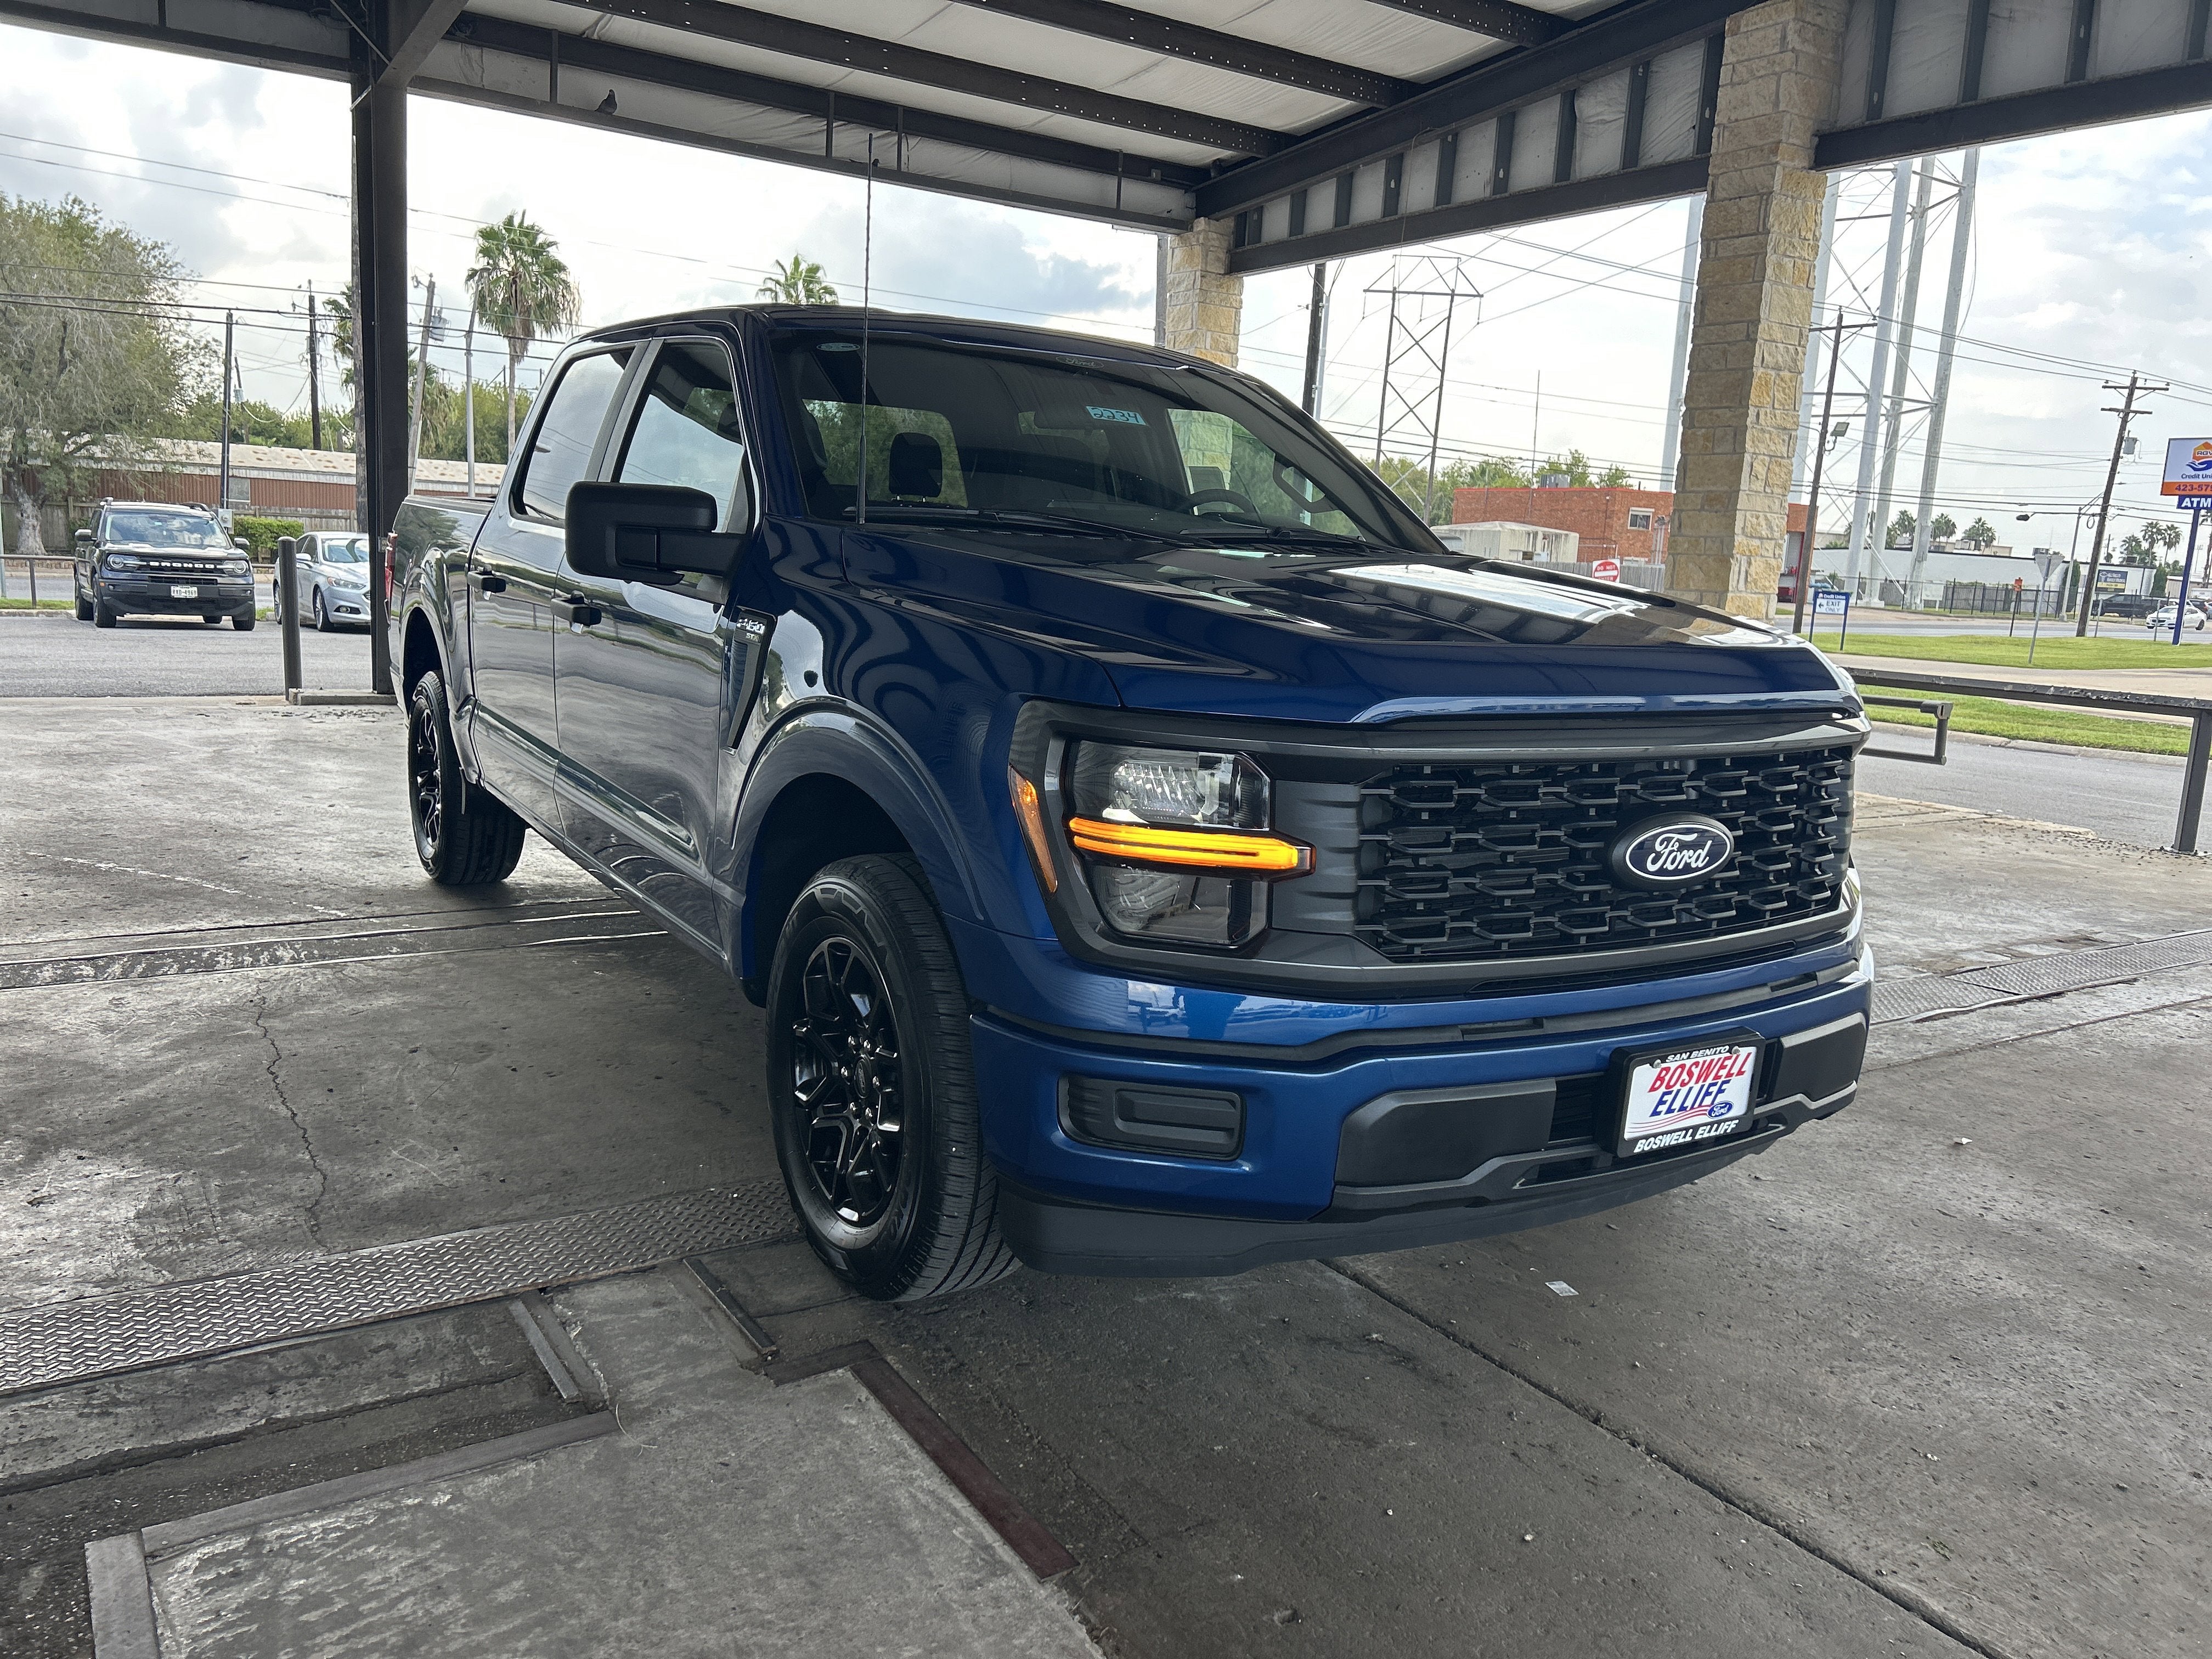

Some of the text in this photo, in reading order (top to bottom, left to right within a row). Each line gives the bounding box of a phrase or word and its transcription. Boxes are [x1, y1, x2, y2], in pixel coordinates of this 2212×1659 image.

[1091, 408, 1139, 424] 2234
[2181, 498, 2211, 507] ATM
[1647, 833, 1712, 871] Ford
[1666, 1045, 1729, 1063] SAN BENITO
[1647, 1052, 1752, 1093] BOSWELL
[1649, 1079, 1731, 1117] ELLIFF
[1712, 1103, 1729, 1117] Ford
[1634, 1120, 1739, 1153] BOSWELL ELLIFF
